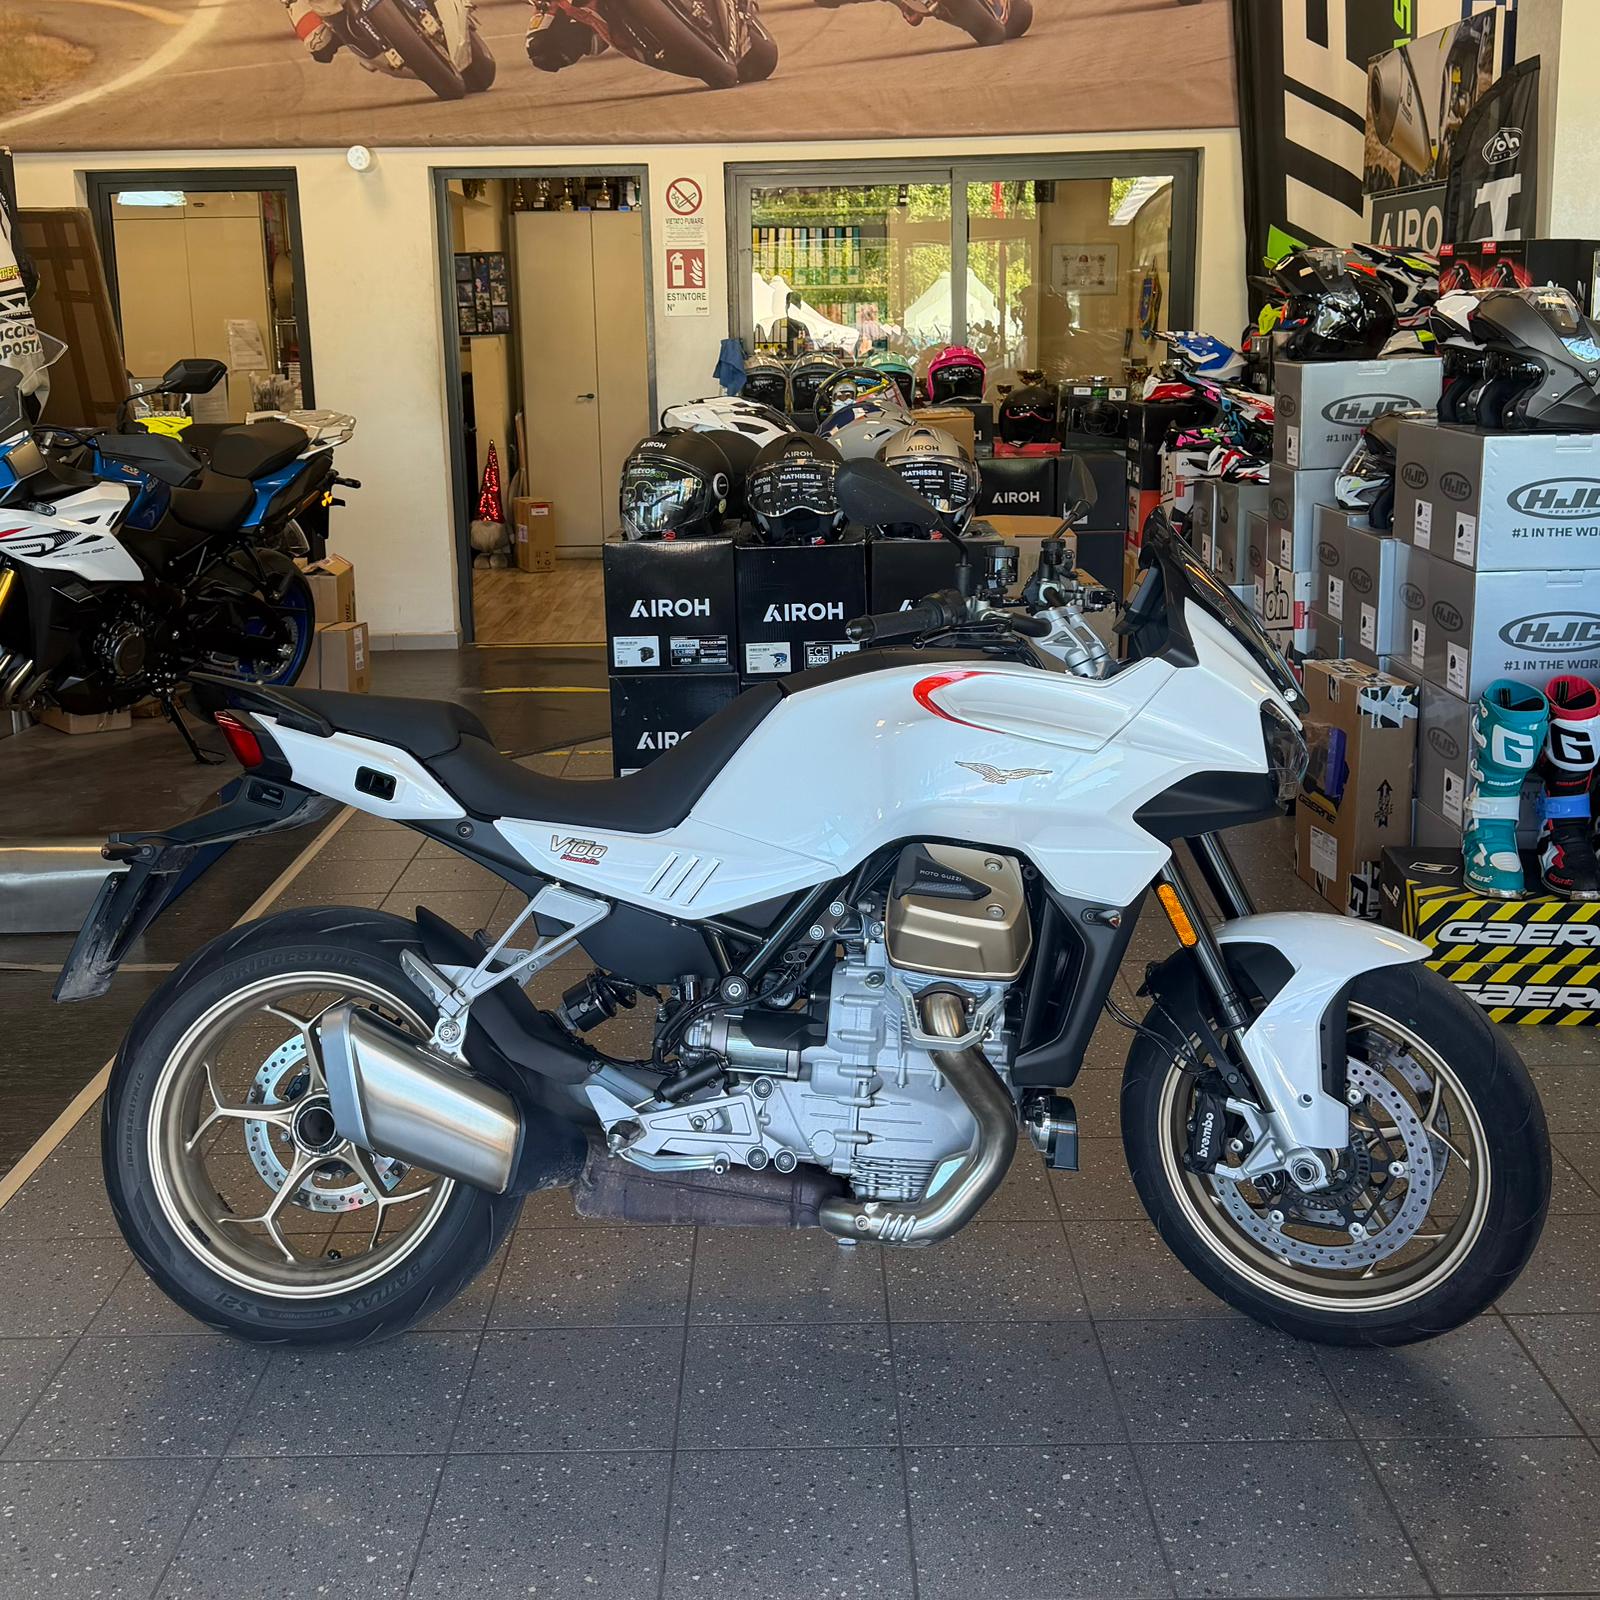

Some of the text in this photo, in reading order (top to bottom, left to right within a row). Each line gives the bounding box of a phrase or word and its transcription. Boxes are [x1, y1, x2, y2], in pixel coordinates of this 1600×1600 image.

[666, 293, 707, 301] ESTINTORE
[1334, 401, 1409, 420] HJC
[641, 441, 667, 450] AIROH
[1341, 433, 1353, 442] IN
[784, 451, 813, 459] AIROH
[906, 444, 940, 452] AIROH
[901, 469, 937, 477] MATHISSE
[1404, 466, 1425, 485] HJC
[1443, 476, 1468, 497] HJC
[992, 491, 1041, 504] AIROH
[1512, 526, 1600, 538] #1 IN THE WO
[630, 598, 711, 618] AIROH
[763, 602, 844, 623] AIROH
[1434, 605, 1460, 628] HJC
[808, 647, 829, 656] ECE
[1504, 659, 1600, 670] #1 IN THE WOR
[636, 731, 692, 750] AIR
[1491, 724, 1534, 769] G
[1550, 721, 1595, 765] G
[550, 834, 609, 858] V100
[919, 869, 962, 882] MOTO GUZZI
[218, 950, 361, 985] BRIDGESTONE
[1196, 1112, 1215, 1158] brembo
